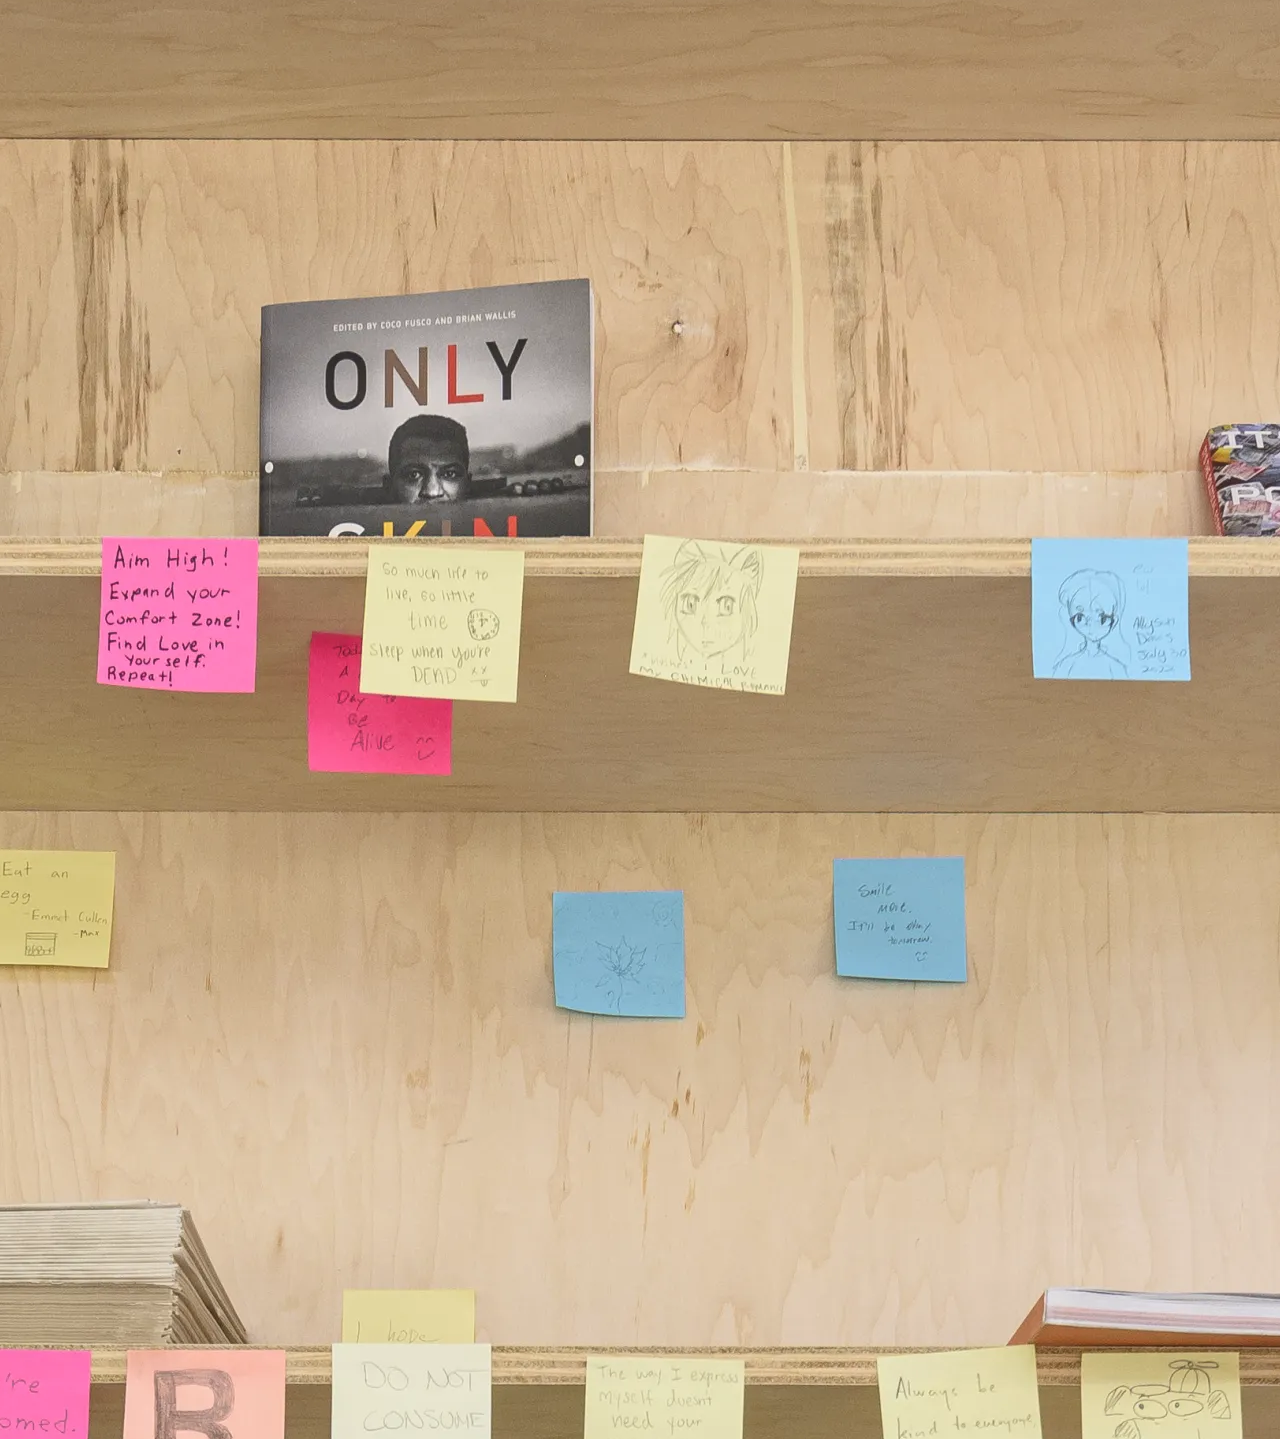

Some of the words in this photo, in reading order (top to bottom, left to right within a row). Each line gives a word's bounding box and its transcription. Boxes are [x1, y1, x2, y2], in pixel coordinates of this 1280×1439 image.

[333, 323, 363, 332] EDITED
[367, 322, 377, 330] BY
[380, 320, 401, 329] COCO
[405, 318, 432, 328] FUSCO
[435, 317, 453, 325] AND
[456, 315, 482, 323] BRIAN
[485, 311, 516, 321] WALLIS
[325, 339, 528, 410] ONLY
[114, 545, 149, 569] Aim
[110, 582, 175, 602] Expand
[187, 588, 230, 603] your
[105, 610, 177, 625] Comfort
[108, 632, 146, 651] Find
[159, 636, 198, 652] Love
[209, 638, 224, 650] in
[108, 666, 172, 687] Repeat!
[2, 862, 32, 876] Eat
[51, 870, 68, 878] an
[0, 890, 30, 904] egg
[362, 1362, 409, 1390] DO
[426, 1368, 489, 1390] NOT
[363, 1410, 486, 1432] CONSUME
